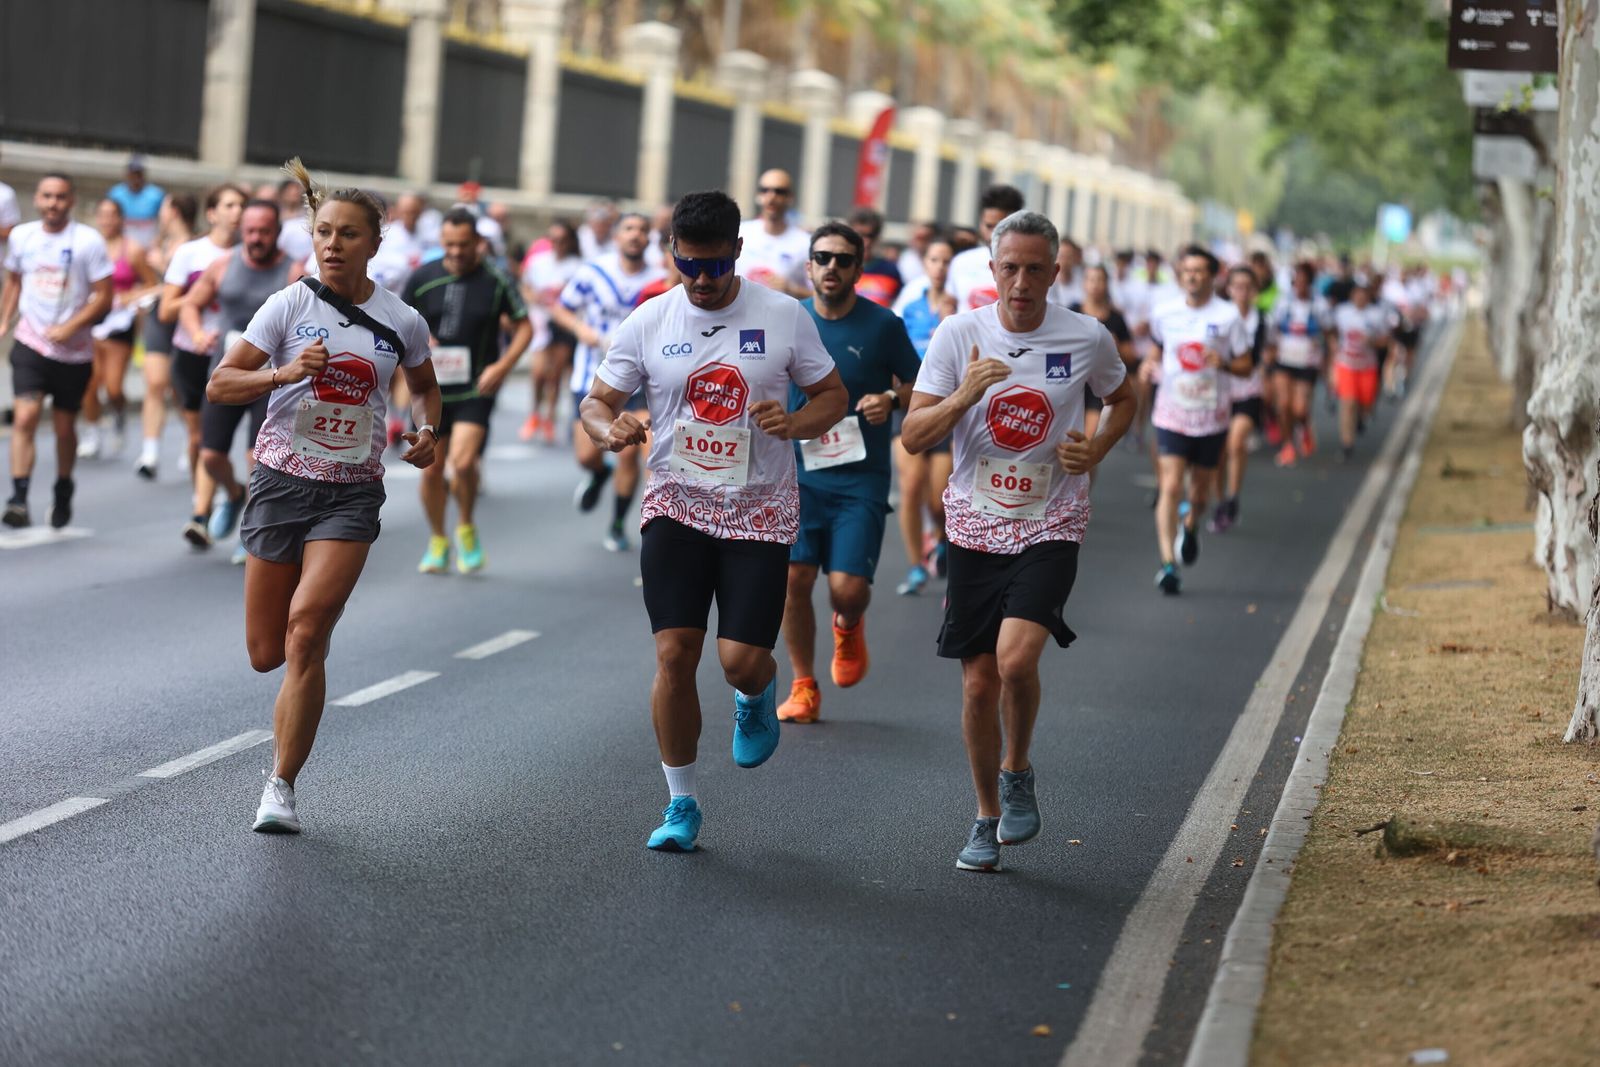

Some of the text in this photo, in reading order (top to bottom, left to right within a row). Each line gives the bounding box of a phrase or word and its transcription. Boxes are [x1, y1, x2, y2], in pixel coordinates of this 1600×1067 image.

[739, 341, 761, 352] AXA
[324, 366, 370, 388] PONLE
[1046, 366, 1068, 377] AXA
[695, 380, 741, 400] PONLE
[998, 400, 1046, 424] PONLE
[313, 416, 357, 435] 277
[994, 413, 1041, 437] FRENO
[685, 436, 738, 457] 1007
[820, 431, 841, 445] 81
[990, 473, 1033, 492] 608
